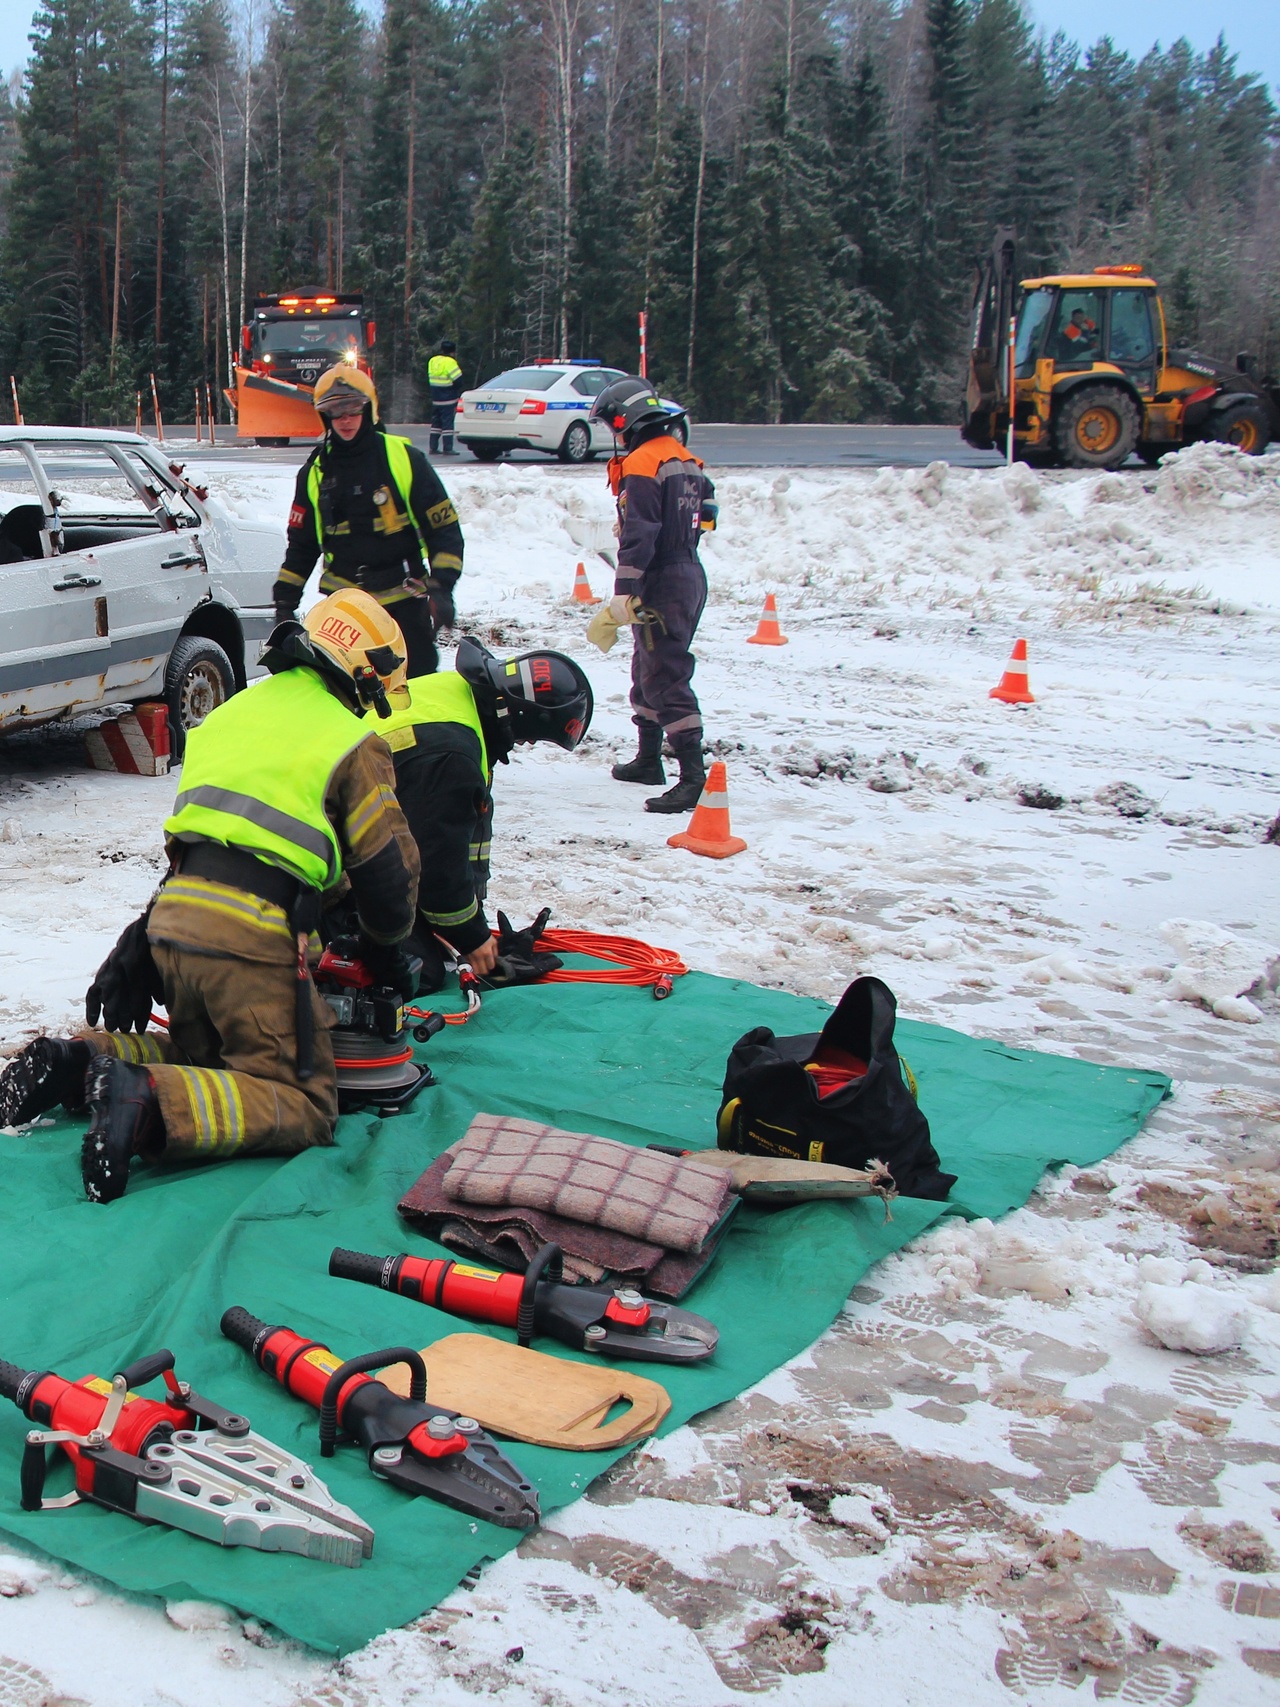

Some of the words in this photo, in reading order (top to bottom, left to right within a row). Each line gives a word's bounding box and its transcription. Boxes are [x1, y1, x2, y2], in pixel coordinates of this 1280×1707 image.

[1186, 361, 1216, 375] VOLVO
[320, 616, 362, 648] СПСЧ
[533, 659, 552, 692] СПСЧ
